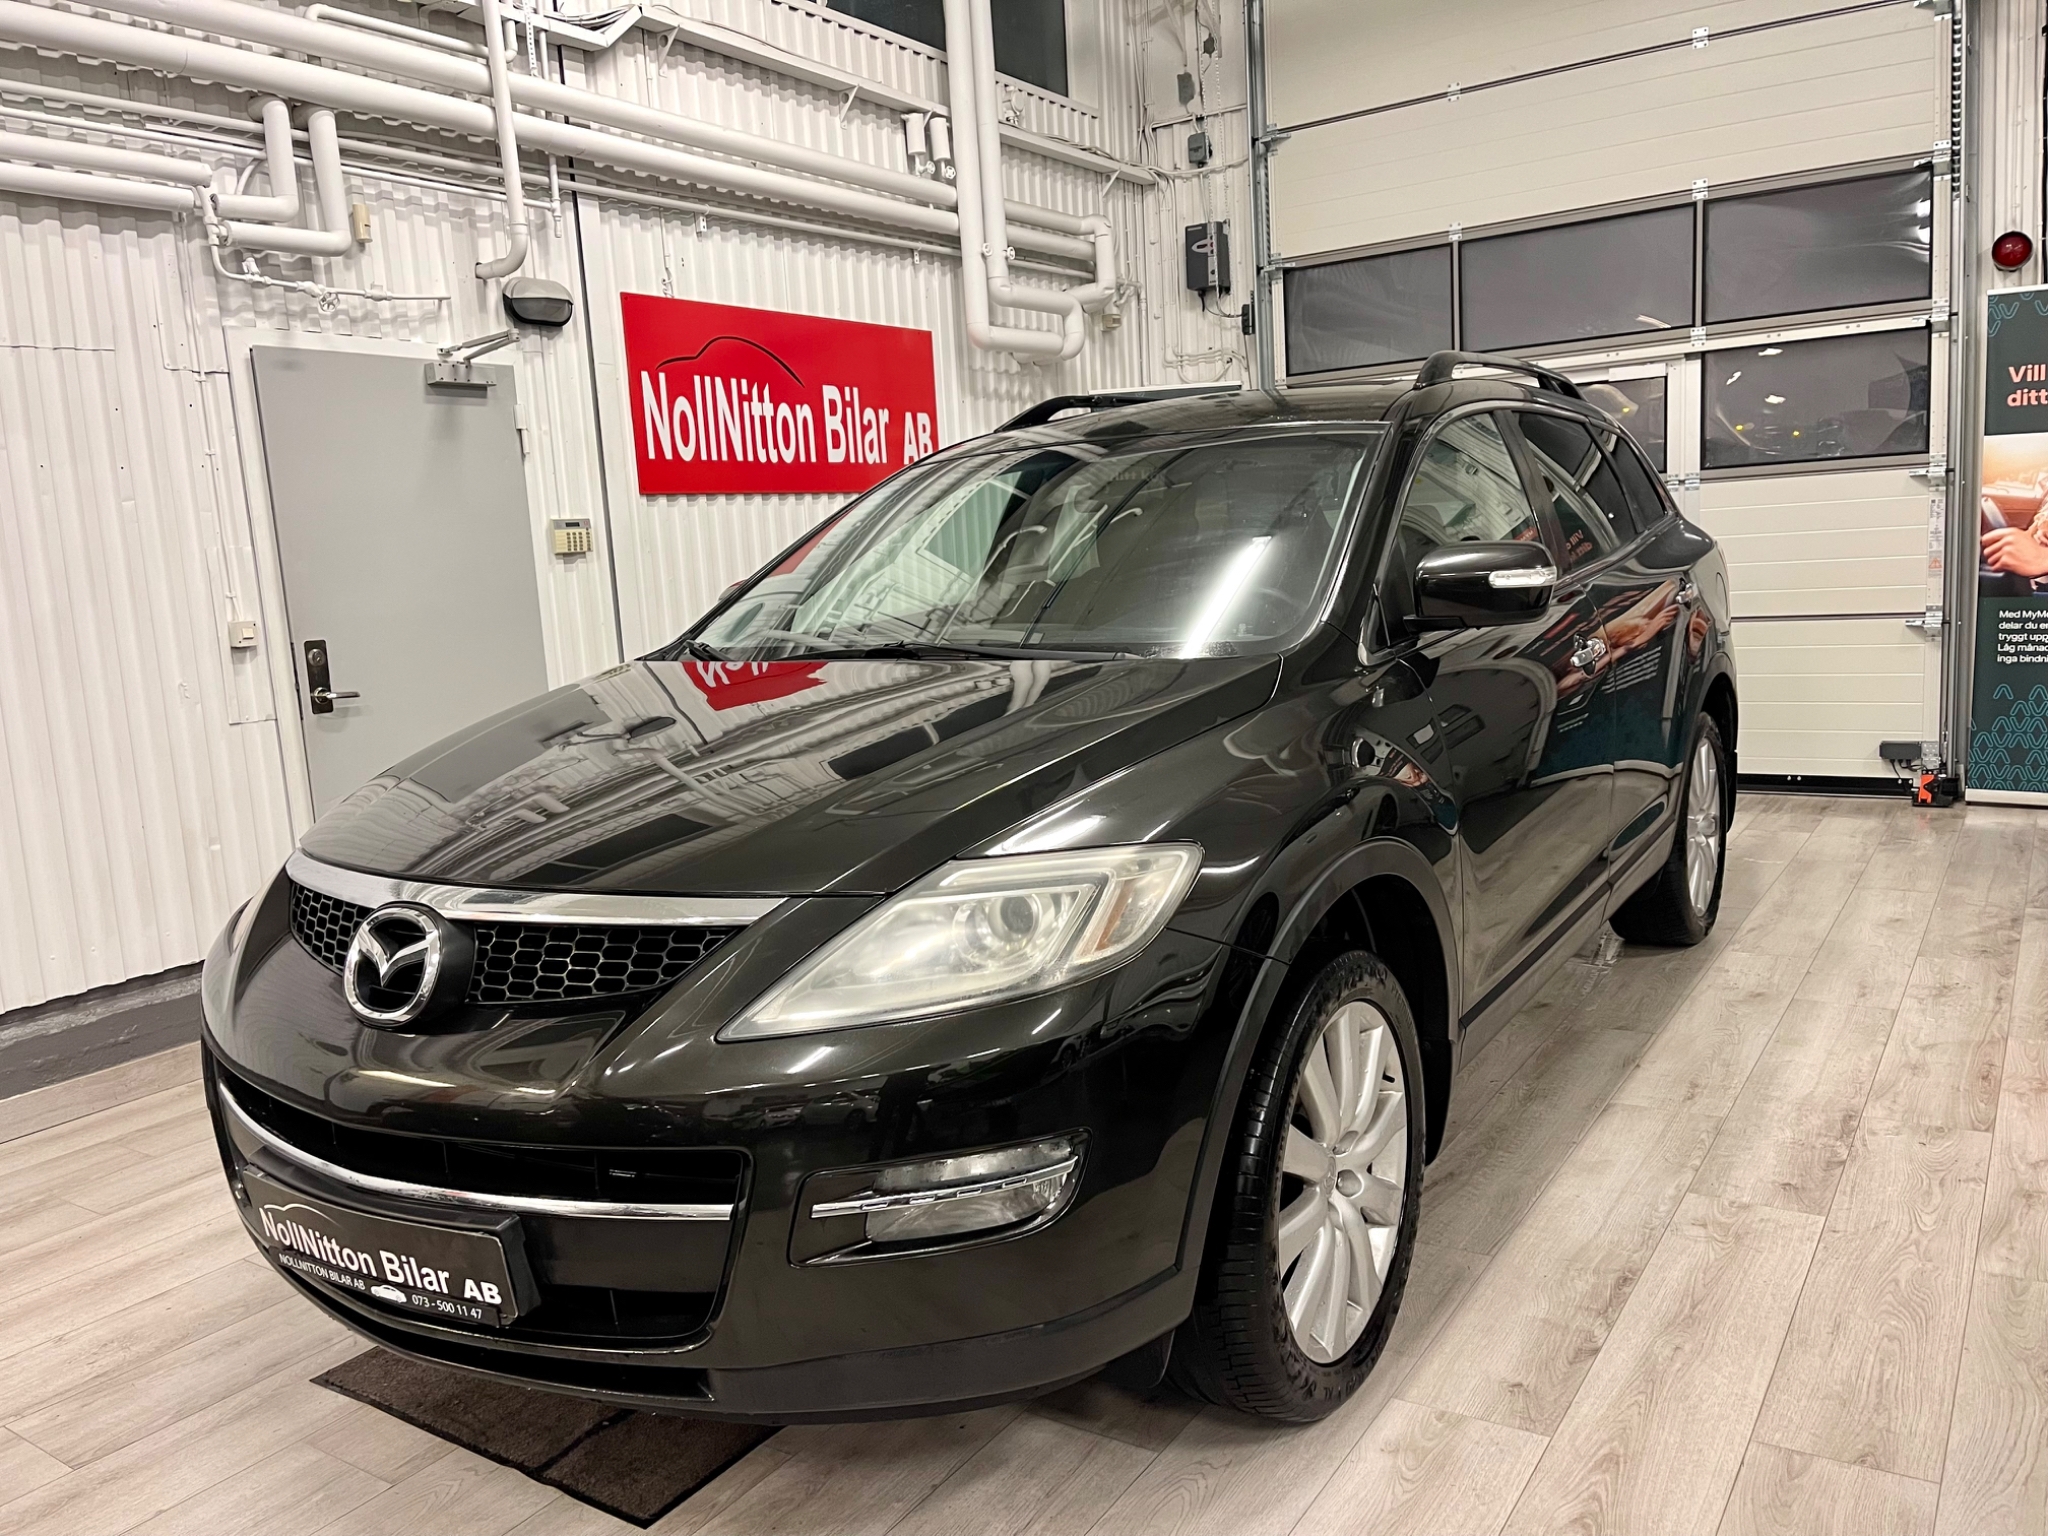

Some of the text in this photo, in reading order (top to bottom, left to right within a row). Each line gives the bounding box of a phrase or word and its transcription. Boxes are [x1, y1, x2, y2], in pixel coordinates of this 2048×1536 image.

[2008, 364, 2046, 383] Vill
[2007, 388, 2048, 407] ditt
[640, 370, 934, 465] NollNitton Bilar AB
[1999, 610, 2048, 620] Med MyM
[1998, 621, 2023, 629] delar
[2024, 621, 2038, 629] du
[1998, 633, 2048, 643] tryggt upp
[1997, 643, 2016, 653] Låg
[259, 1207, 502, 1305] NollNitton Bilar AB
[279, 1253, 366, 1290] NOLLNITTON BILAR AB
[411, 1294, 430, 1308] 073
[436, 1300, 455, 1314] 500
[456, 1304, 468, 1316] 11
[470, 1308, 482, 1319] 47
